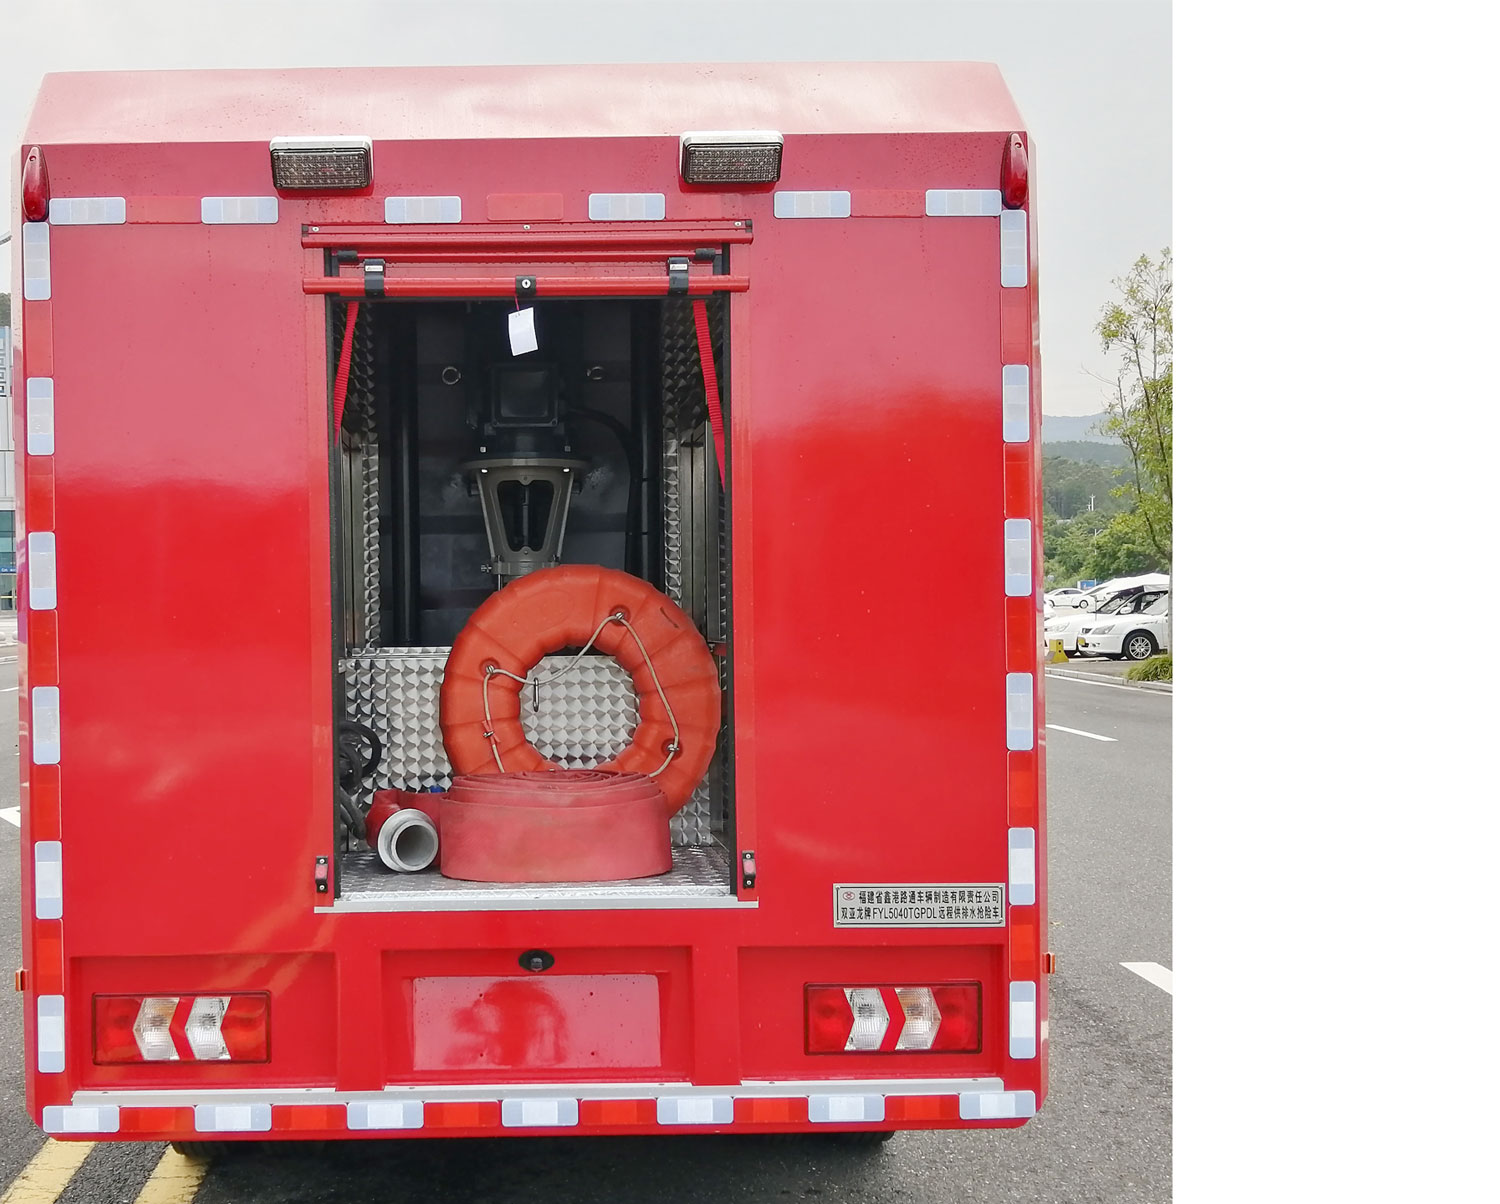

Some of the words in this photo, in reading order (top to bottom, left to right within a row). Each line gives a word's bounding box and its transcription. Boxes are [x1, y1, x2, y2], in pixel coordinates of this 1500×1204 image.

[858, 890, 999, 904] 福建省鑫港路通车辆制造有限责任公司
